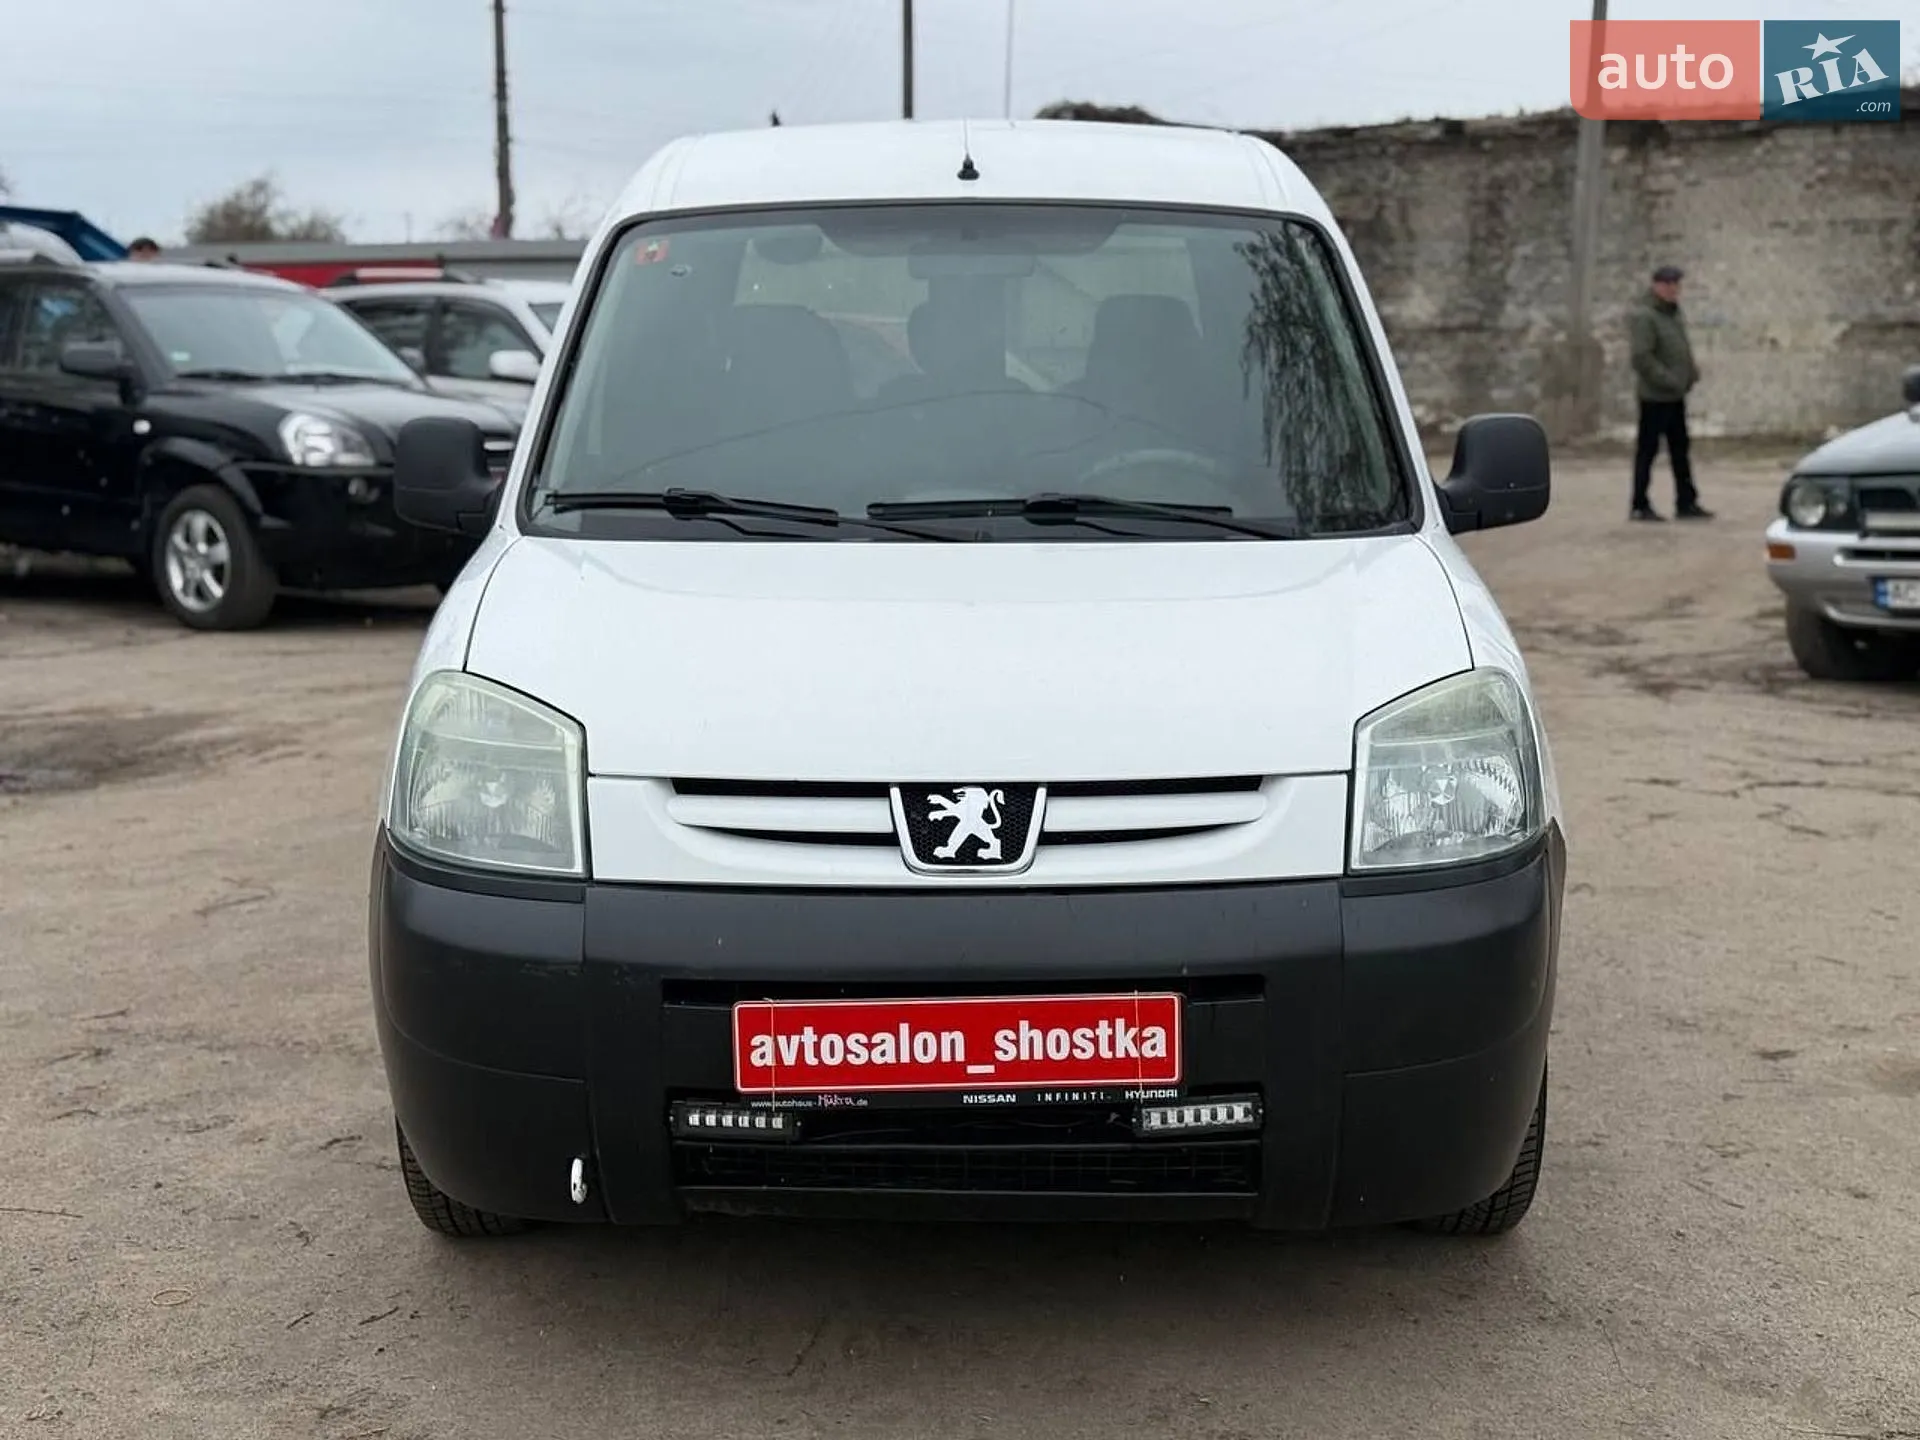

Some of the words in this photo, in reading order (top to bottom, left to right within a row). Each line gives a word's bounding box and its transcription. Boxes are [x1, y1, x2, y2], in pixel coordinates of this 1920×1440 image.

[749, 1018, 1167, 1074] avtosalon_shostka
[963, 1093, 1017, 1104] NISSAN
[1037, 1091, 1104, 1103] INFINITI
[1125, 1089, 1178, 1100] HYUNDAI
